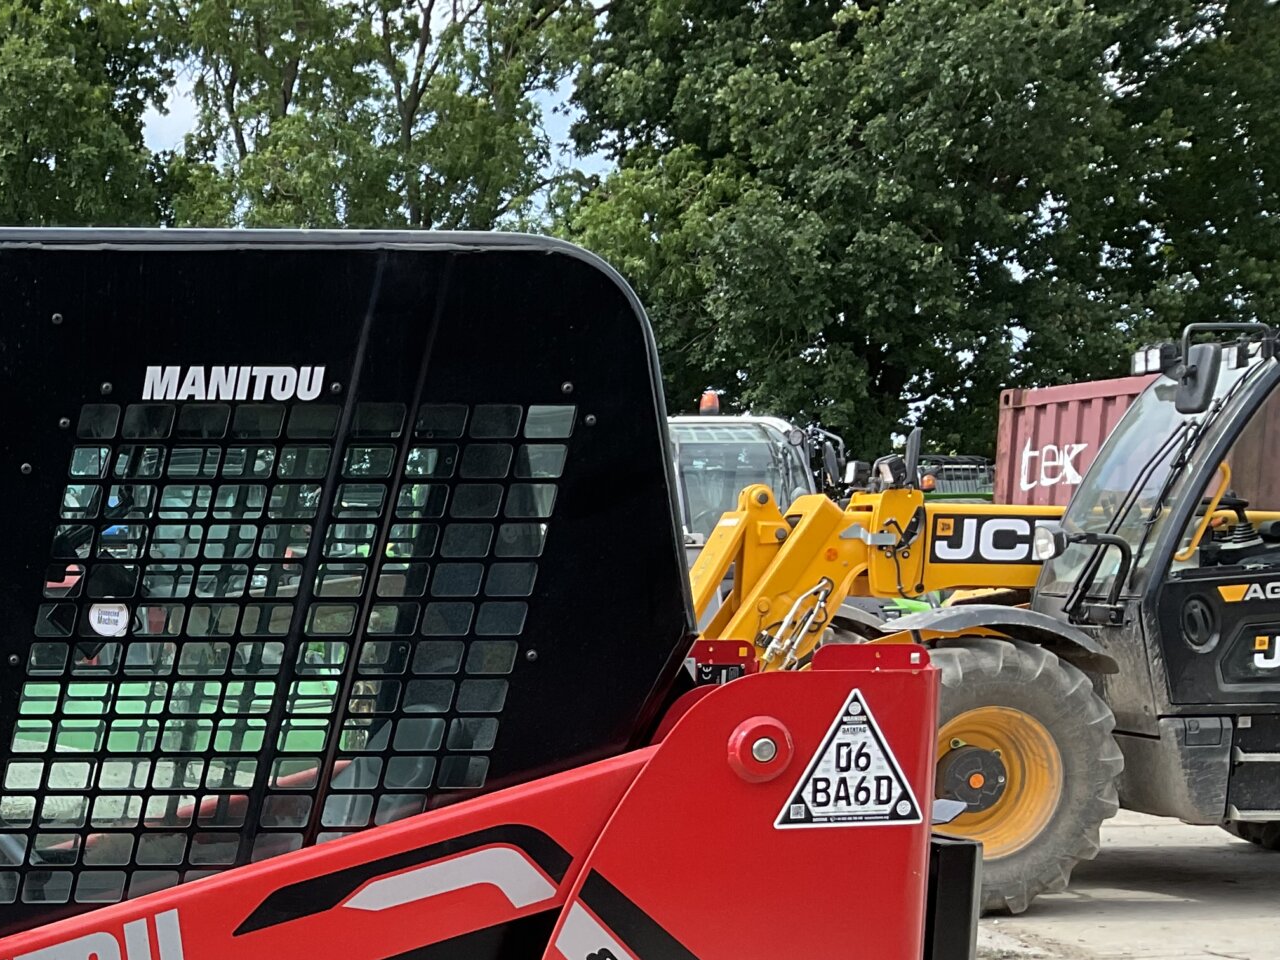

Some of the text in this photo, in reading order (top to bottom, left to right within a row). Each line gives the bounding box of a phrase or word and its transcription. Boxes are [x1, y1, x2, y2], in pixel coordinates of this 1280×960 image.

[142, 365, 326, 401] MANITOU
[1020, 436, 1089, 491] tex
[811, 775, 893, 807] BA6D
